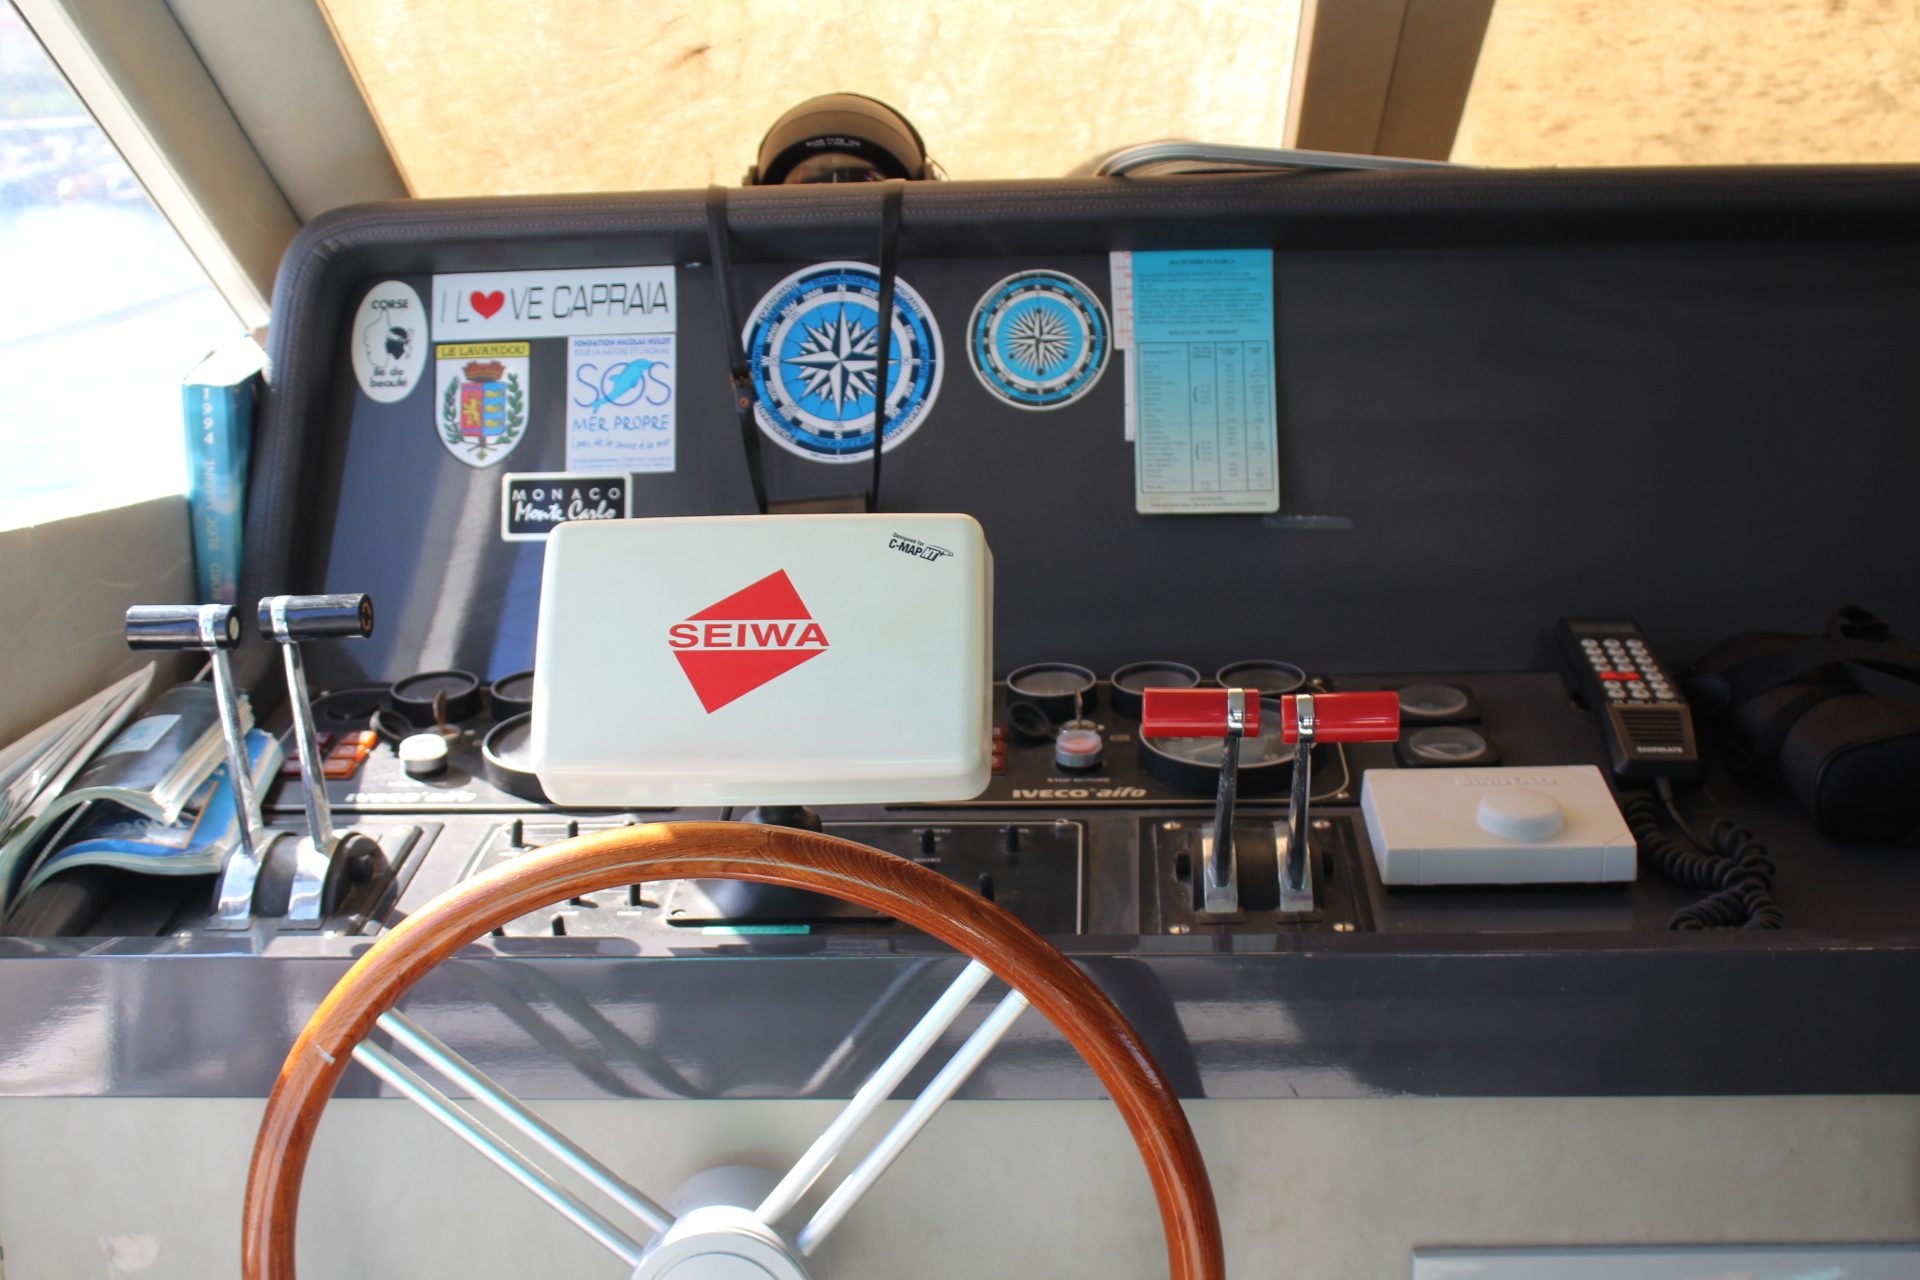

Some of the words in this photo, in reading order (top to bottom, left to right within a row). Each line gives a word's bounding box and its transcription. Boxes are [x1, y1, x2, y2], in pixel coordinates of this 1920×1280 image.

[370, 298, 409, 310] CORSE
[440, 290, 447, 324] I
[552, 280, 670, 318] CAPRAIA
[440, 347, 454, 357] LE
[458, 344, 525, 357] LAVANDOU
[573, 360, 672, 408] SOS
[202, 387, 216, 446] 1994
[571, 415, 609, 432] MER
[613, 413, 670, 431] PROPRE
[202, 458, 218, 512] MARINE
[511, 486, 622, 502] MONACO
[513, 500, 566, 523] Monte
[567, 499, 617, 522] Carlo
[888, 538, 923, 557] C-MAP
[892, 531, 918, 545] Designed
[667, 622, 831, 649] SEIWA
[1012, 788, 1089, 799] IVECO
[1095, 786, 1147, 799] aifo
